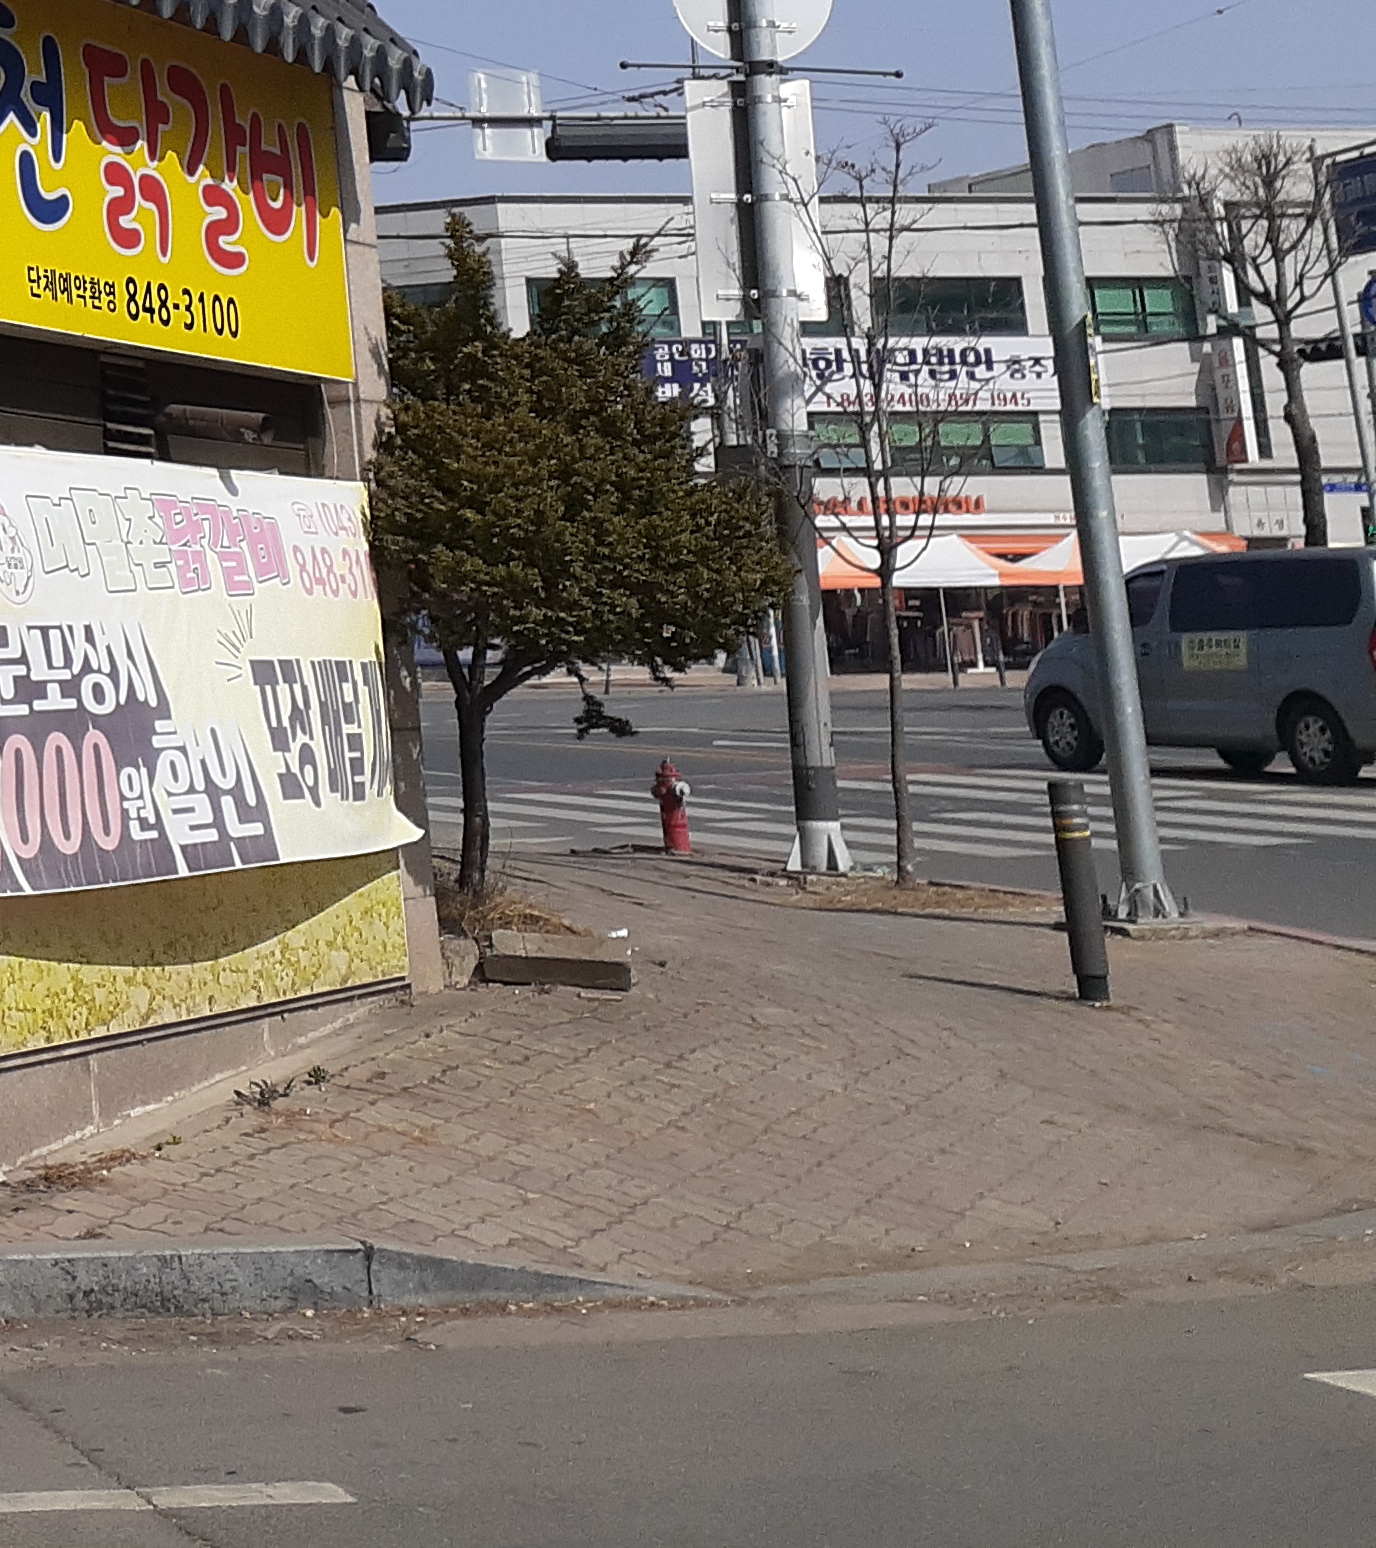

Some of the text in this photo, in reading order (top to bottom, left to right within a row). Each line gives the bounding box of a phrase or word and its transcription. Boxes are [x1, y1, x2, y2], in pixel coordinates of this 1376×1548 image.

[81, 43, 319, 274] 닭갈비
[27, 265, 240, 339] 단체예약환영 848-3100
[1007, 355, 1056, 381] 충주
